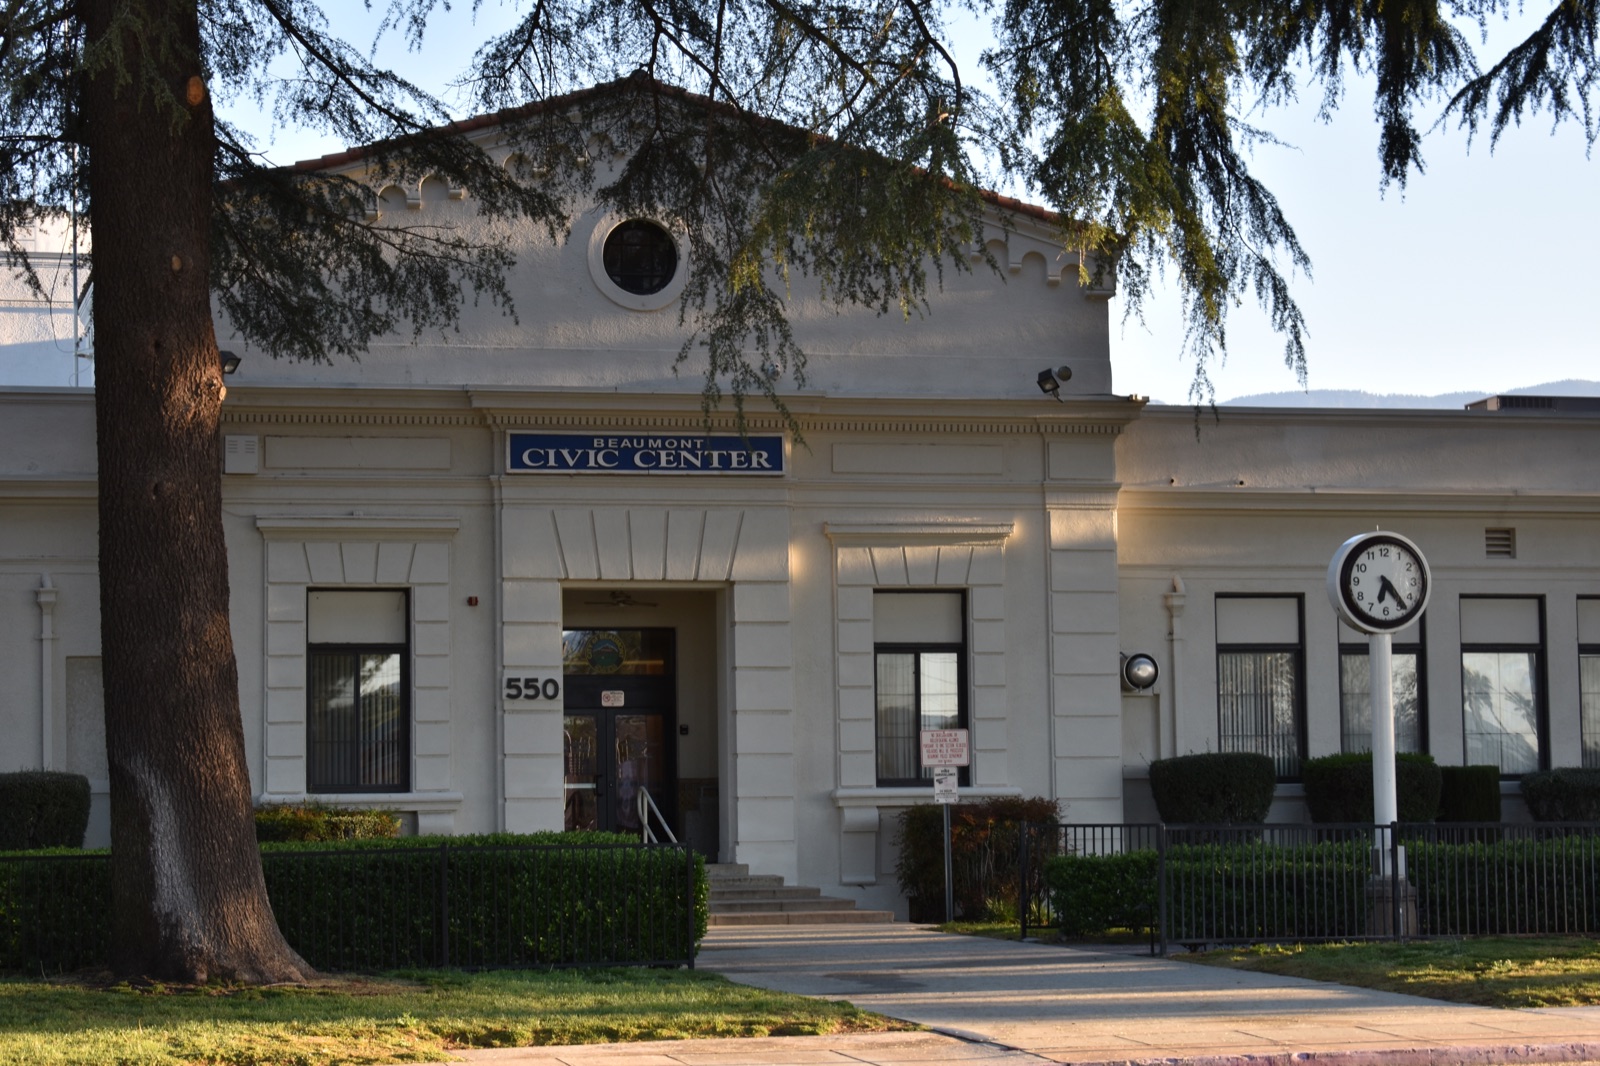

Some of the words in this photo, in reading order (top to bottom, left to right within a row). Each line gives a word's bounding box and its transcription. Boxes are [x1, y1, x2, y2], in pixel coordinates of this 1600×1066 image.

[593, 438, 704, 449] BEAUMONT
[522, 448, 619, 467] CIVIC
[633, 449, 773, 469] CENTER
[1367, 551, 1375, 560] 11
[1379, 548, 1389, 557] 12
[1397, 552, 1401, 560] 1
[1356, 563, 1367, 573] 10
[1406, 562, 1412, 571] 2
[1353, 577, 1360, 586] 9
[1411, 578, 1417, 587] 3
[1357, 592, 1364, 601] 8
[1368, 603, 1374, 611] 7
[1383, 607, 1390, 616] 6
[506, 678, 559, 700] 550
